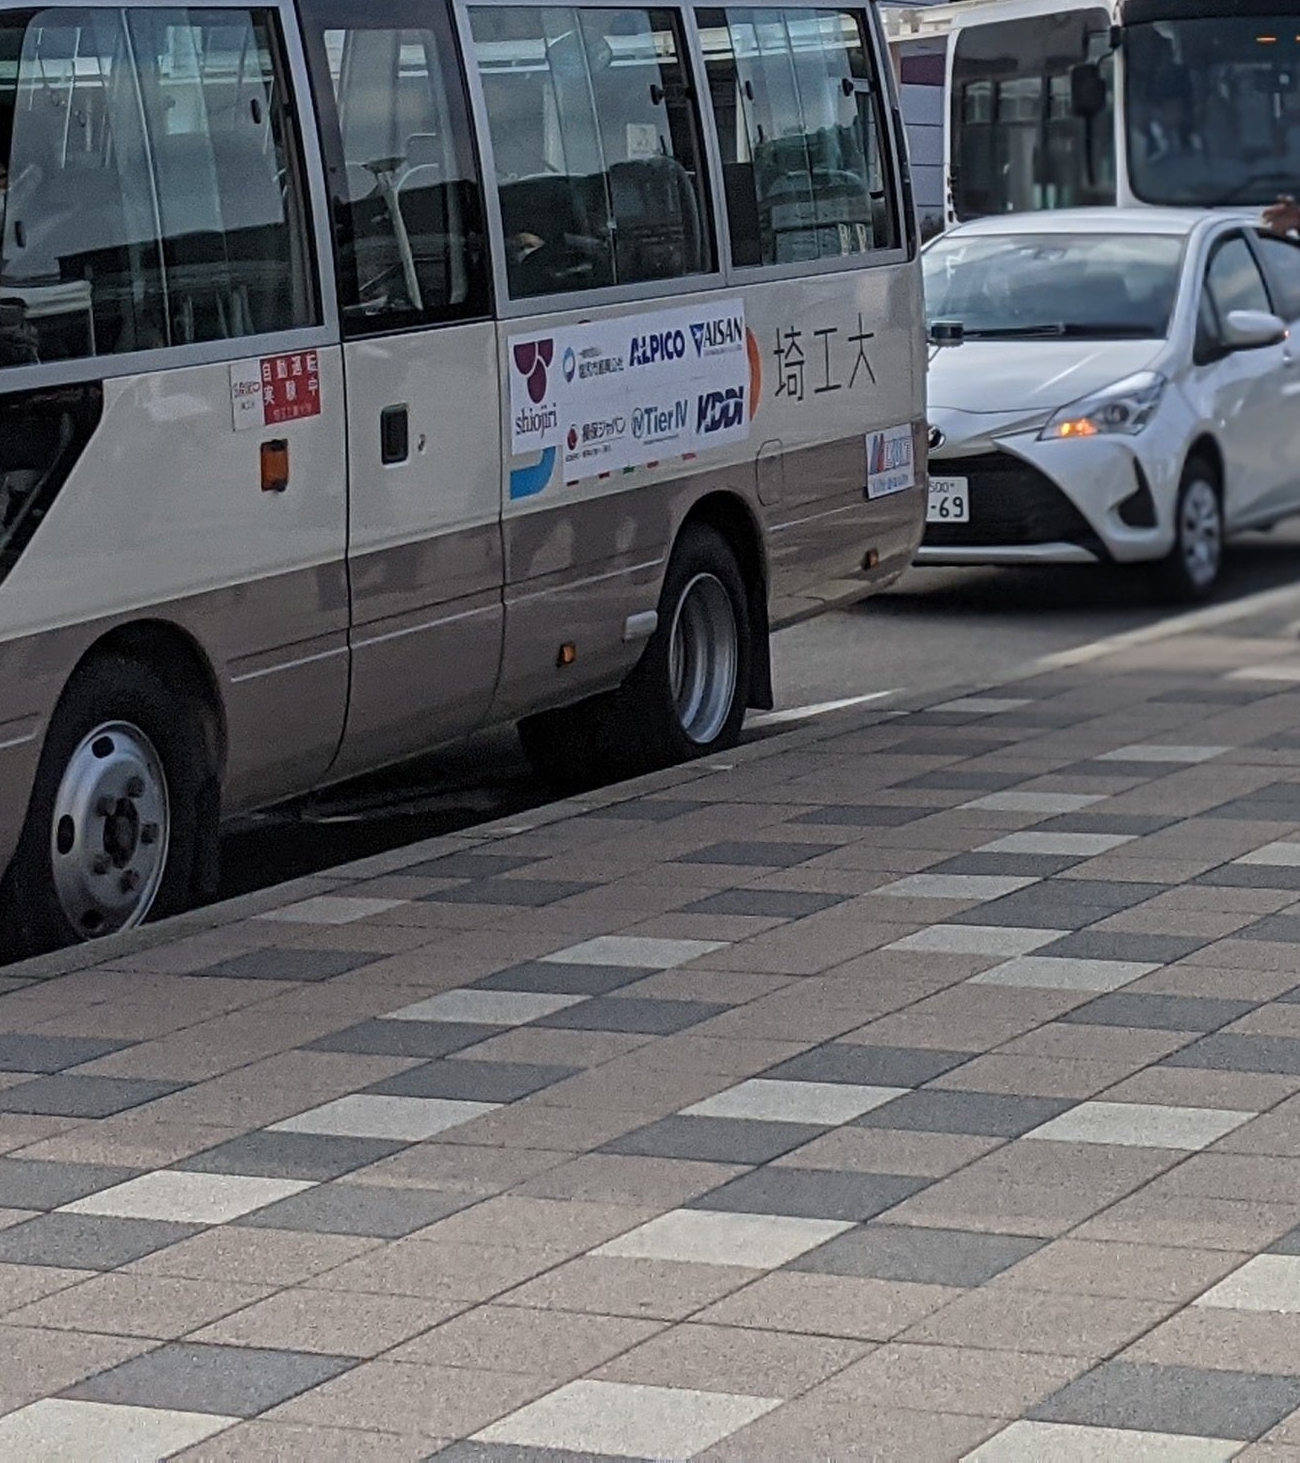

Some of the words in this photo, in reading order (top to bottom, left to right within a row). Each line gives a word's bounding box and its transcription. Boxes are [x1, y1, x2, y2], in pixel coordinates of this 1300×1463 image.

[629, 329, 686, 367] ALPICO
[703, 316, 743, 348] AISAN
[773, 312, 876, 401] 埼工大
[515, 402, 557, 439] shiojiri
[696, 386, 744, 434] KDDI
